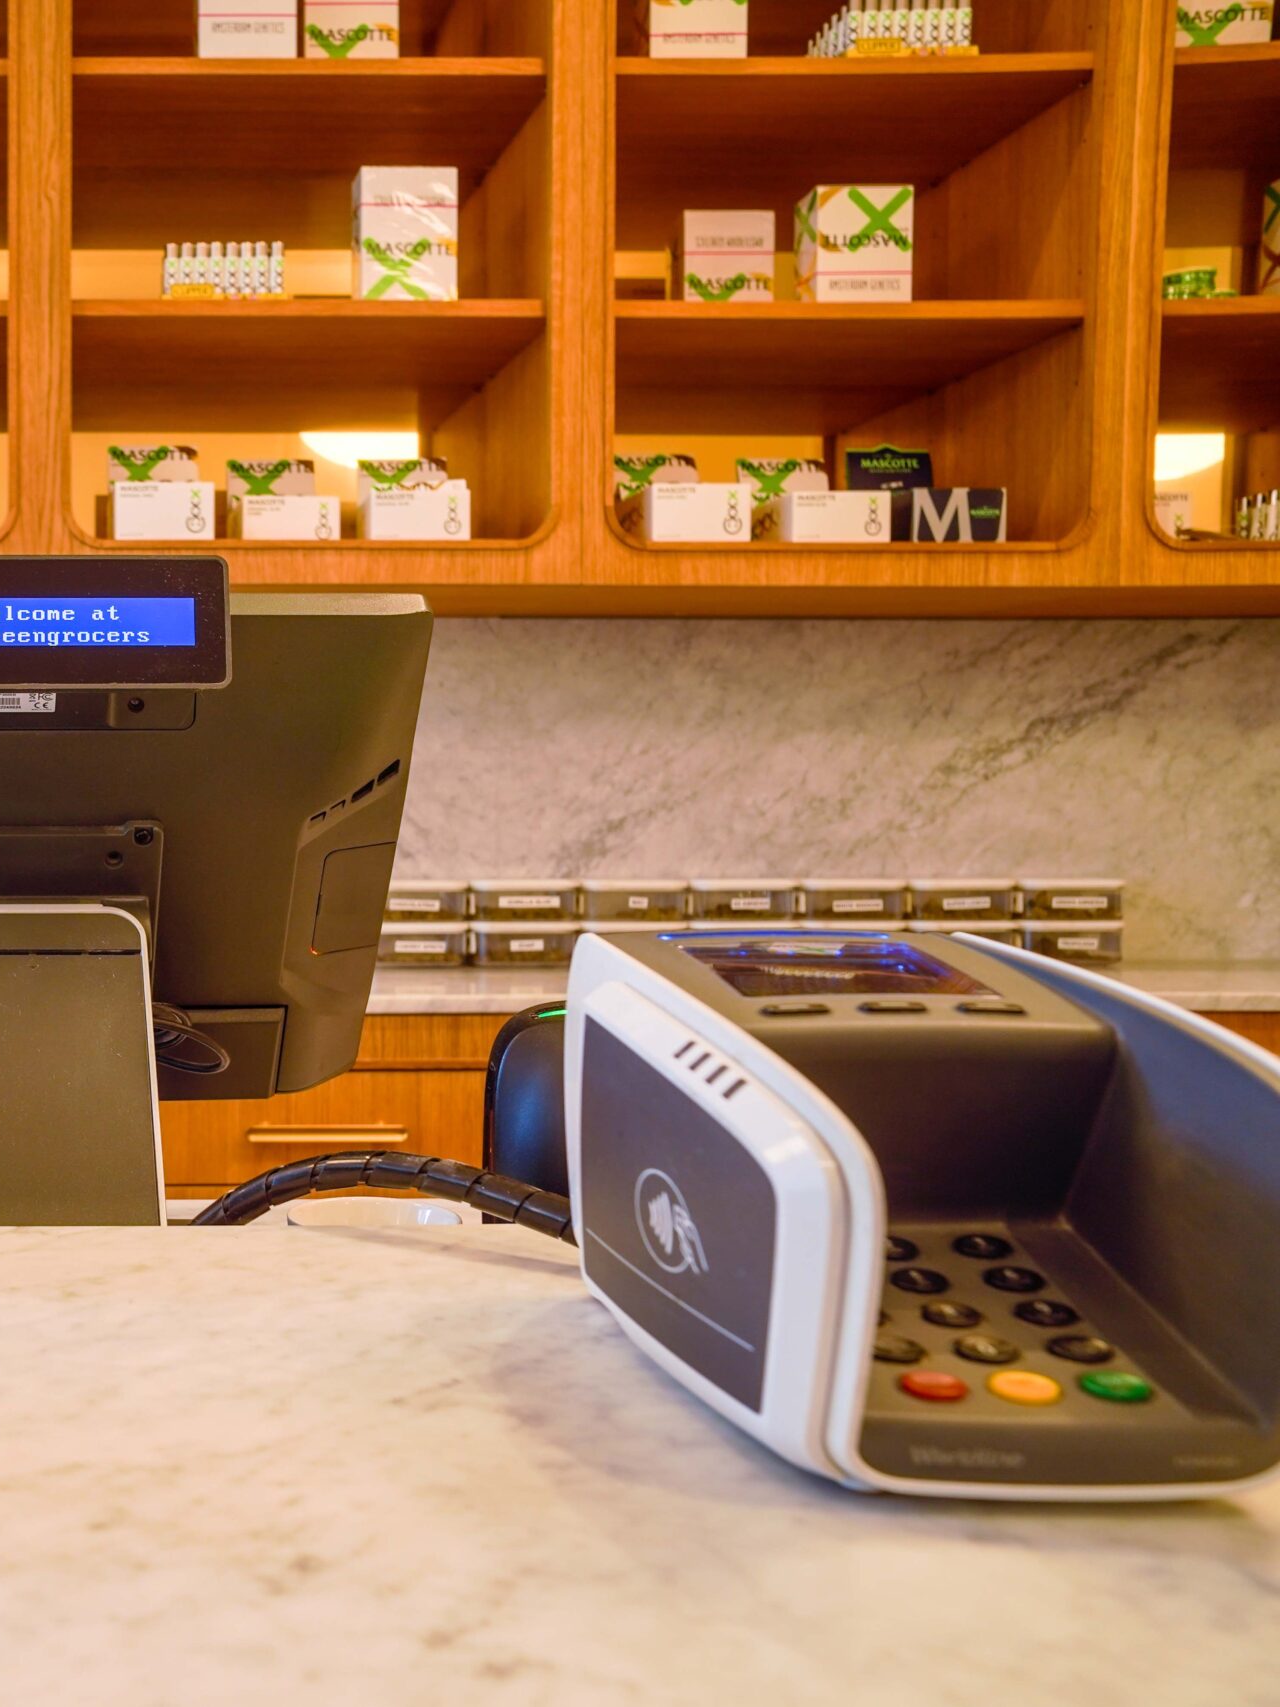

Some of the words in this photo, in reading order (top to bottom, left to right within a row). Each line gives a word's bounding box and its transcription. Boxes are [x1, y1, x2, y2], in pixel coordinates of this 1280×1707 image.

[1177, 7, 1269, 23] MASCOTTE
[309, 29, 395, 42] MASCOTTE
[825, 233, 908, 248] MASCOTTE
[367, 242, 454, 255] MASCOTTE
[688, 277, 770, 291] MASCOTTE
[860, 458, 920, 469] MASCOTTE
[92, 605, 120, 621] at
